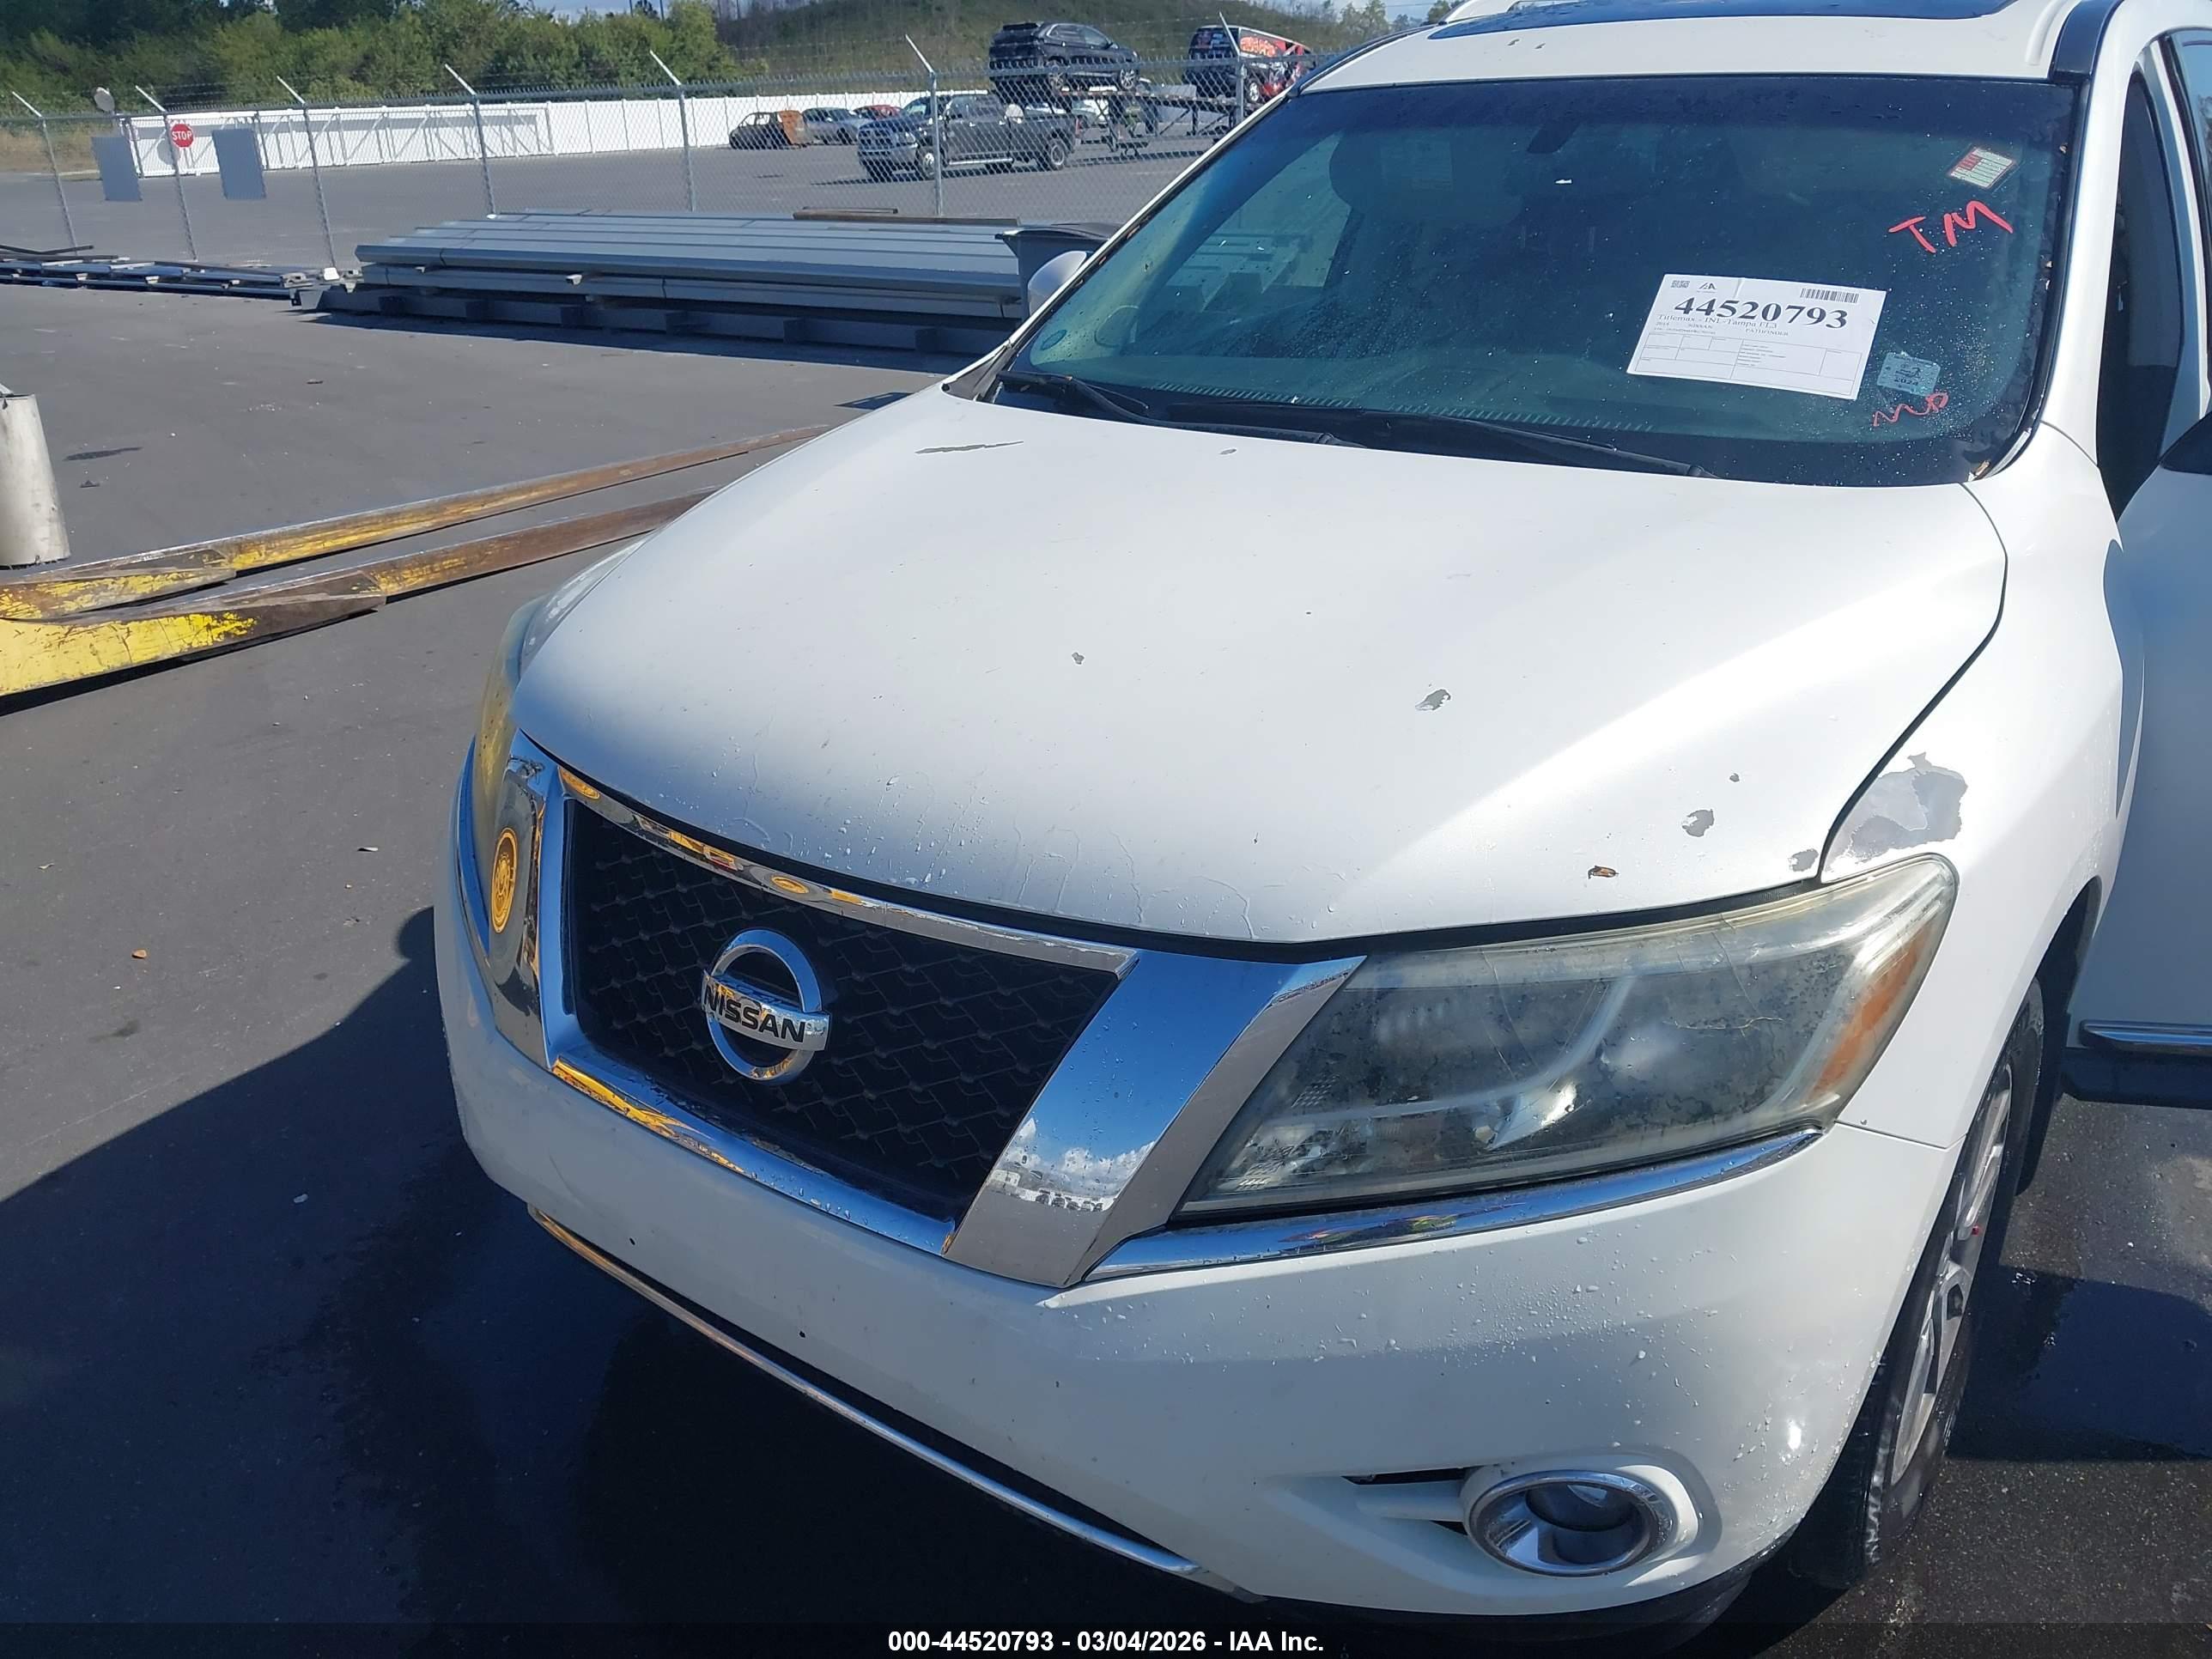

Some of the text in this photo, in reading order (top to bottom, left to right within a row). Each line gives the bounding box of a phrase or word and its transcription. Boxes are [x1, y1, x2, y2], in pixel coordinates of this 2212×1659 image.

[172, 131, 193, 141] STOP
[1889, 200, 2014, 253] TM
[1674, 296, 1849, 329] 44520793
[704, 984, 806, 1043] NISSAN
